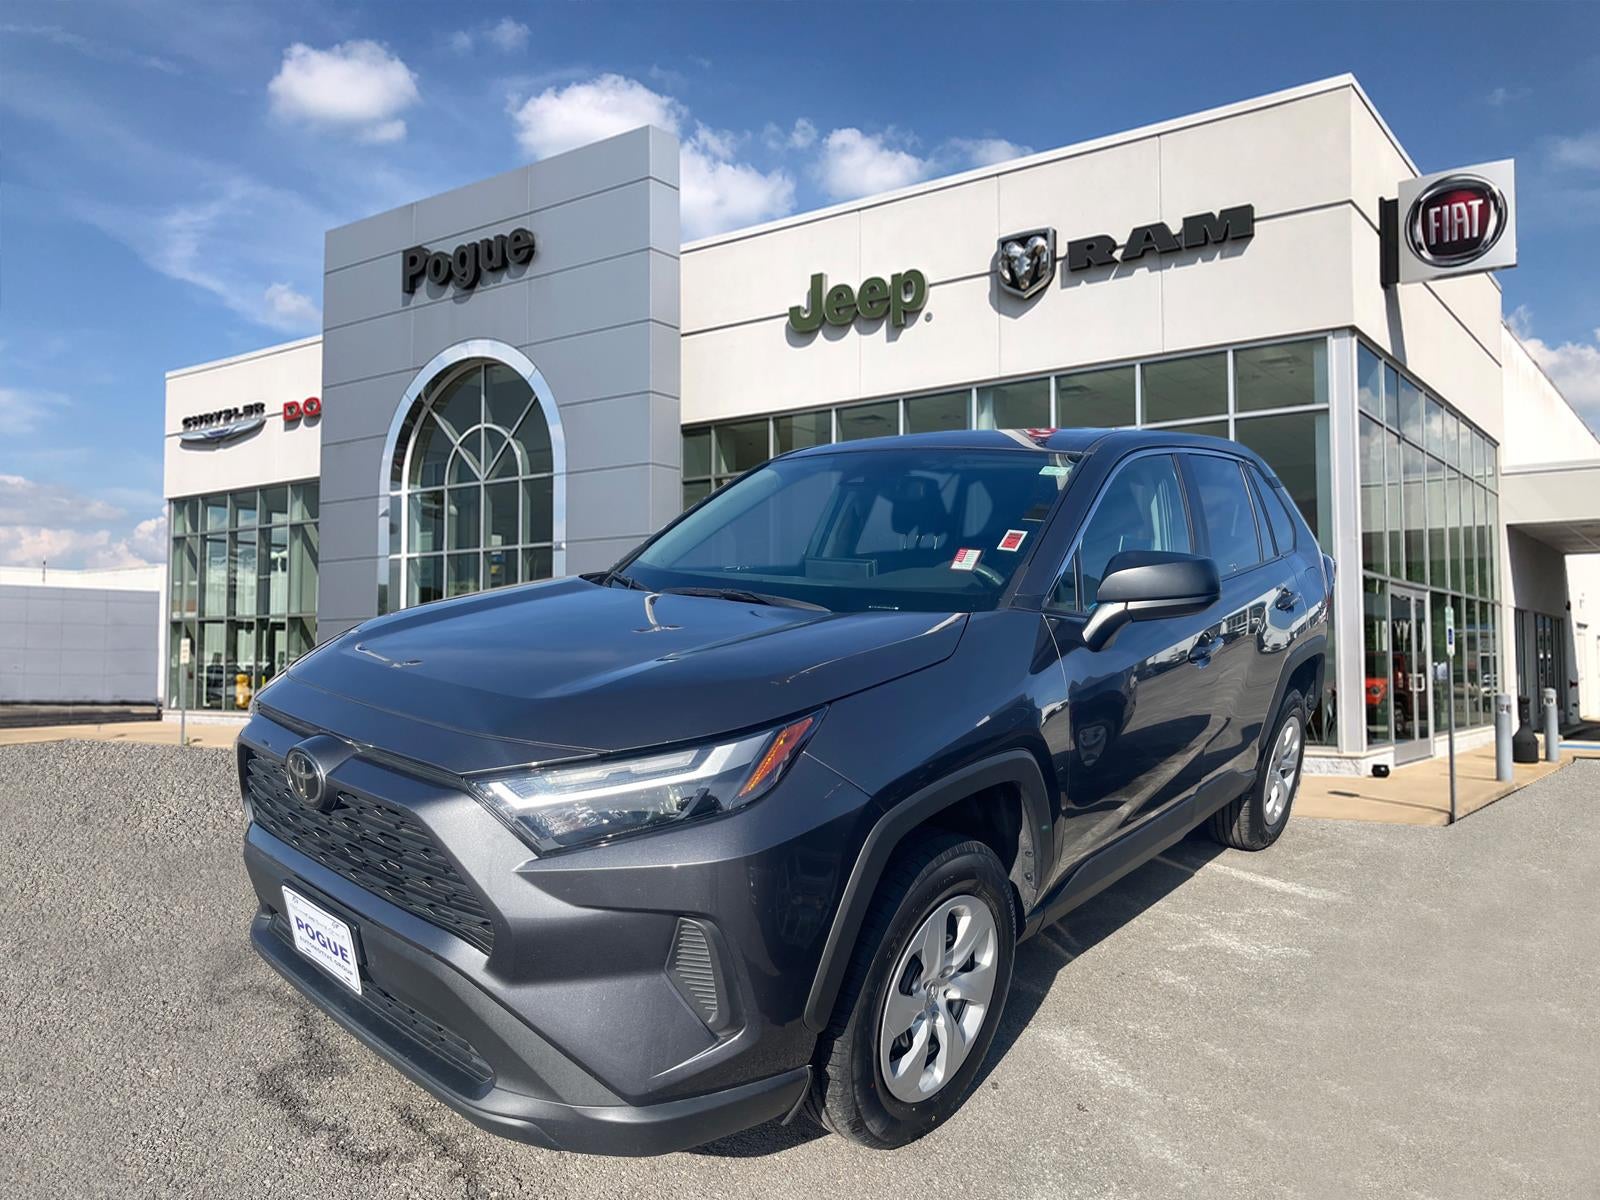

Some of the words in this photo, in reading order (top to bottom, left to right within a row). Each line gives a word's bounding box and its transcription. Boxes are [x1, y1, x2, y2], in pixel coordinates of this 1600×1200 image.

[1067, 203, 1255, 272] RAM
[1428, 198, 1484, 246] FIAT
[402, 227, 535, 294] Pogue
[789, 268, 929, 333] Jeep
[182, 402, 265, 428] CHRYSLER
[295, 915, 351, 965] POGUE
